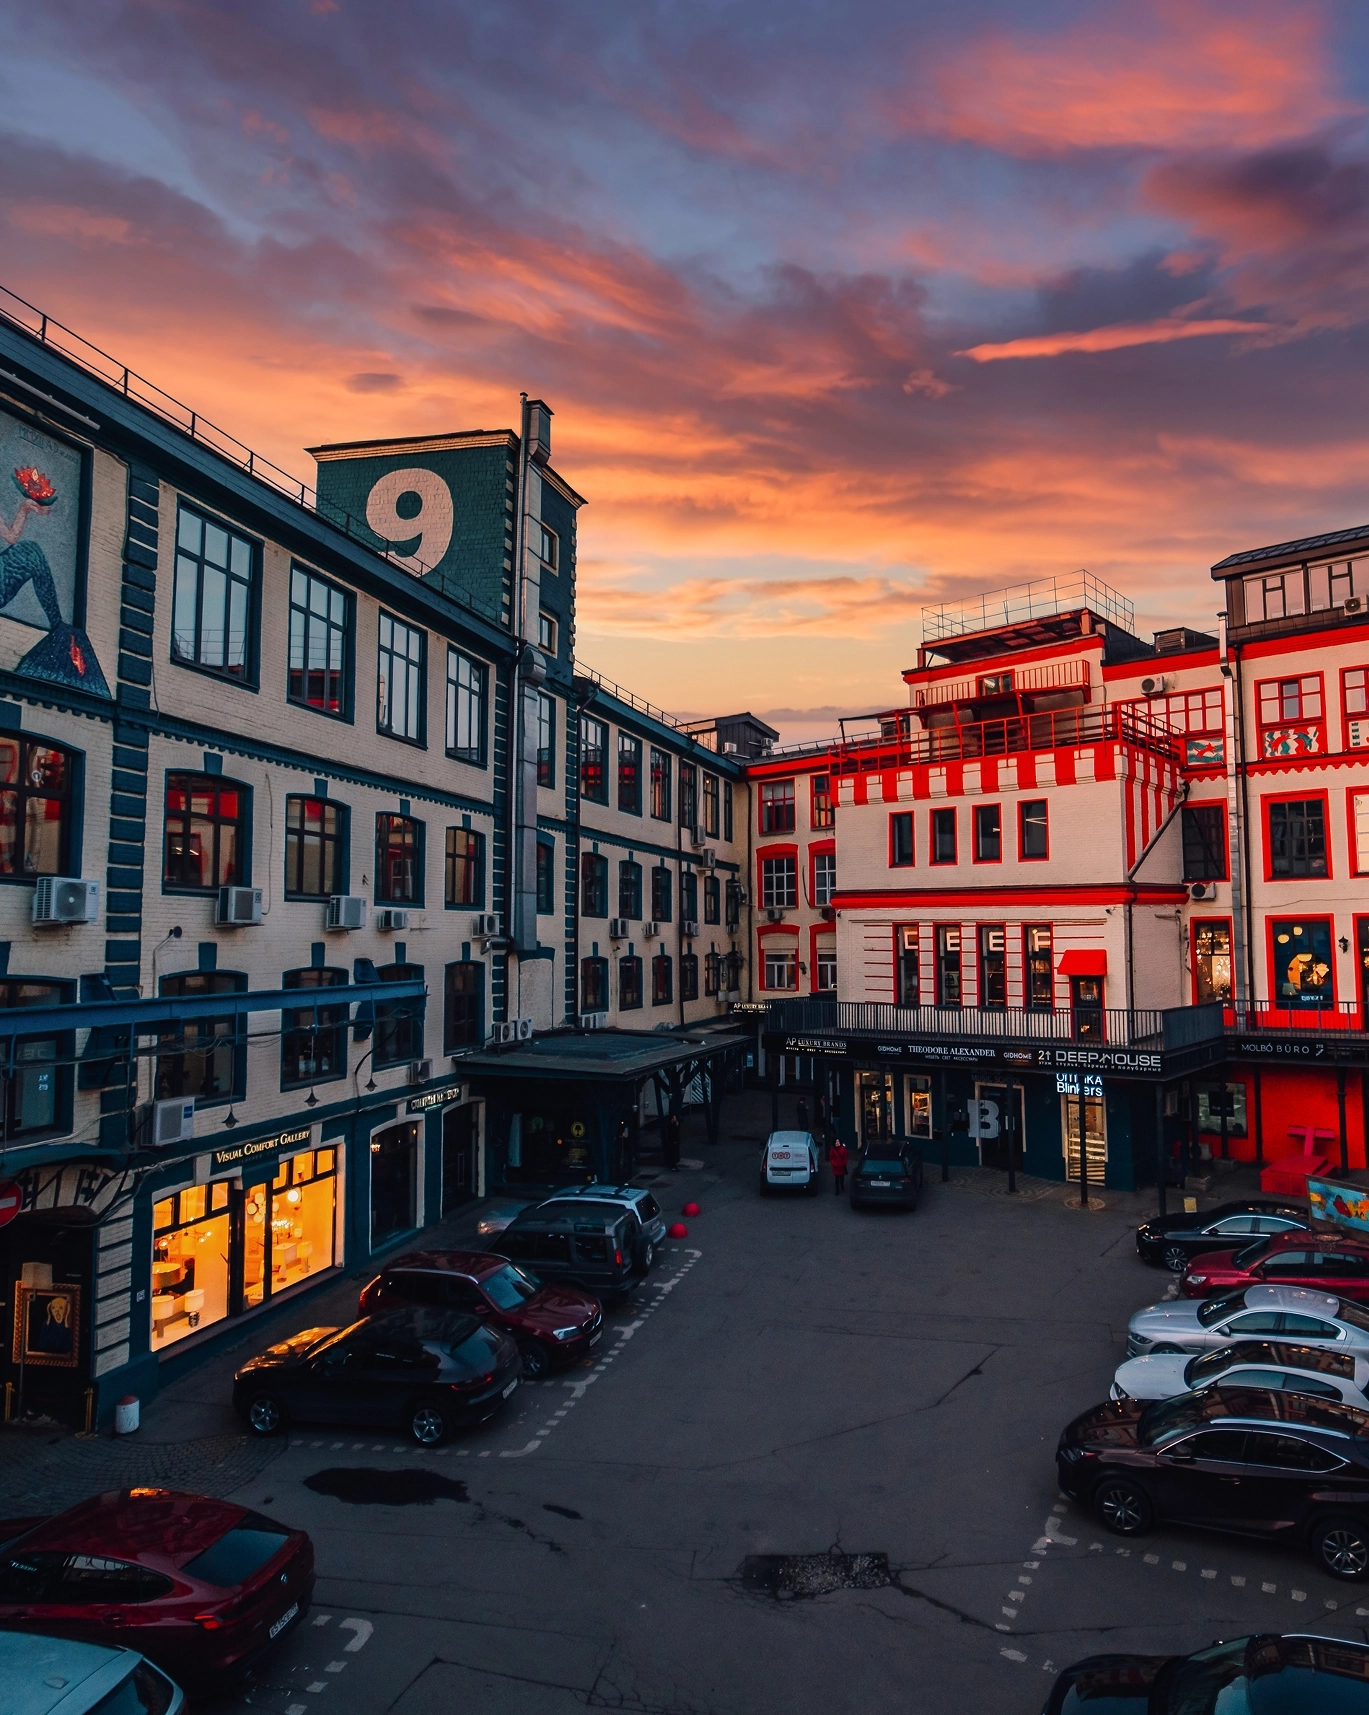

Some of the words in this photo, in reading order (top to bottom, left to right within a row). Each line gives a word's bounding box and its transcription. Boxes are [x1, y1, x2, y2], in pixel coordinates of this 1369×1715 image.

[366, 468, 454, 577] 9
[786, 1037, 797, 1046] AP
[797, 1039, 821, 1048] LUXURY
[822, 1040, 847, 1048] BRANDS
[908, 1045, 949, 1055] THEODORE
[949, 1047, 996, 1057] ALEXANDER
[1003, 1052, 1032, 1060] GIDHOME
[1038, 1050, 1045, 1061] 2
[971, 1074, 993, 1083] MUSIC
[994, 1076, 1022, 1085] SCHOL
